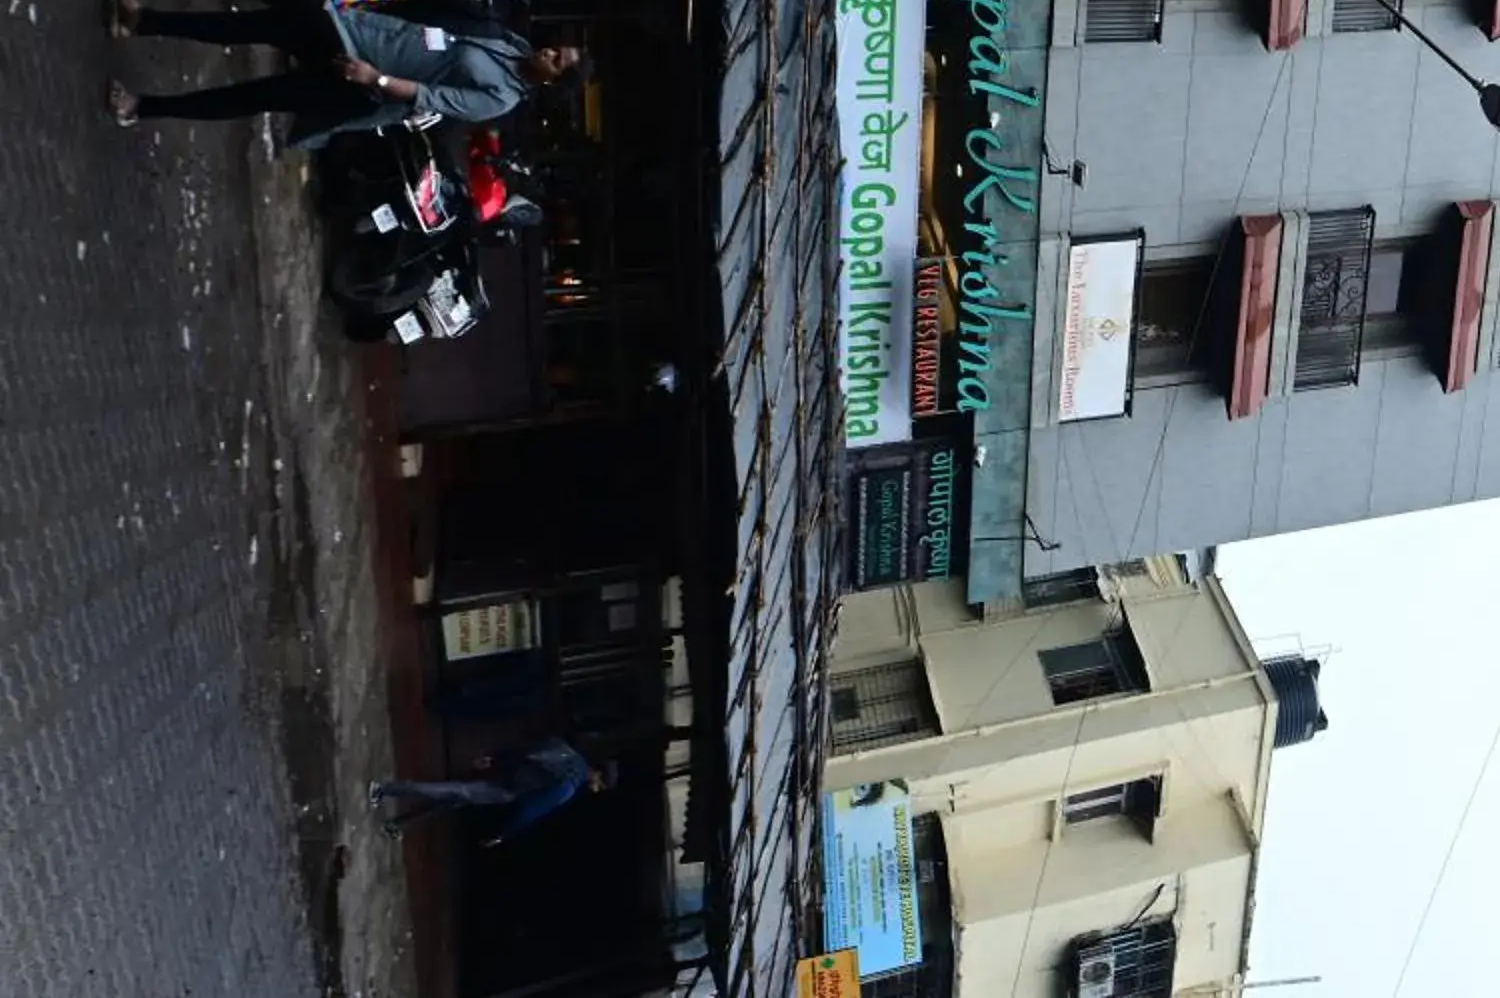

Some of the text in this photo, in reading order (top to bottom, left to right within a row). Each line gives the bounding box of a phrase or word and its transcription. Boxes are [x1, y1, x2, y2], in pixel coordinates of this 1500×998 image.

[858, 110, 909, 172] वेज
[840, 183, 897, 291] Gopal
[956, 129, 1038, 413] Krishna
[844, 301, 893, 439] Krishna
[913, 265, 941, 416] VEG RESTAURANT
[876, 479, 900, 576] Gopal Krishna
[919, 449, 960, 582] गोपाल कृष्णा
